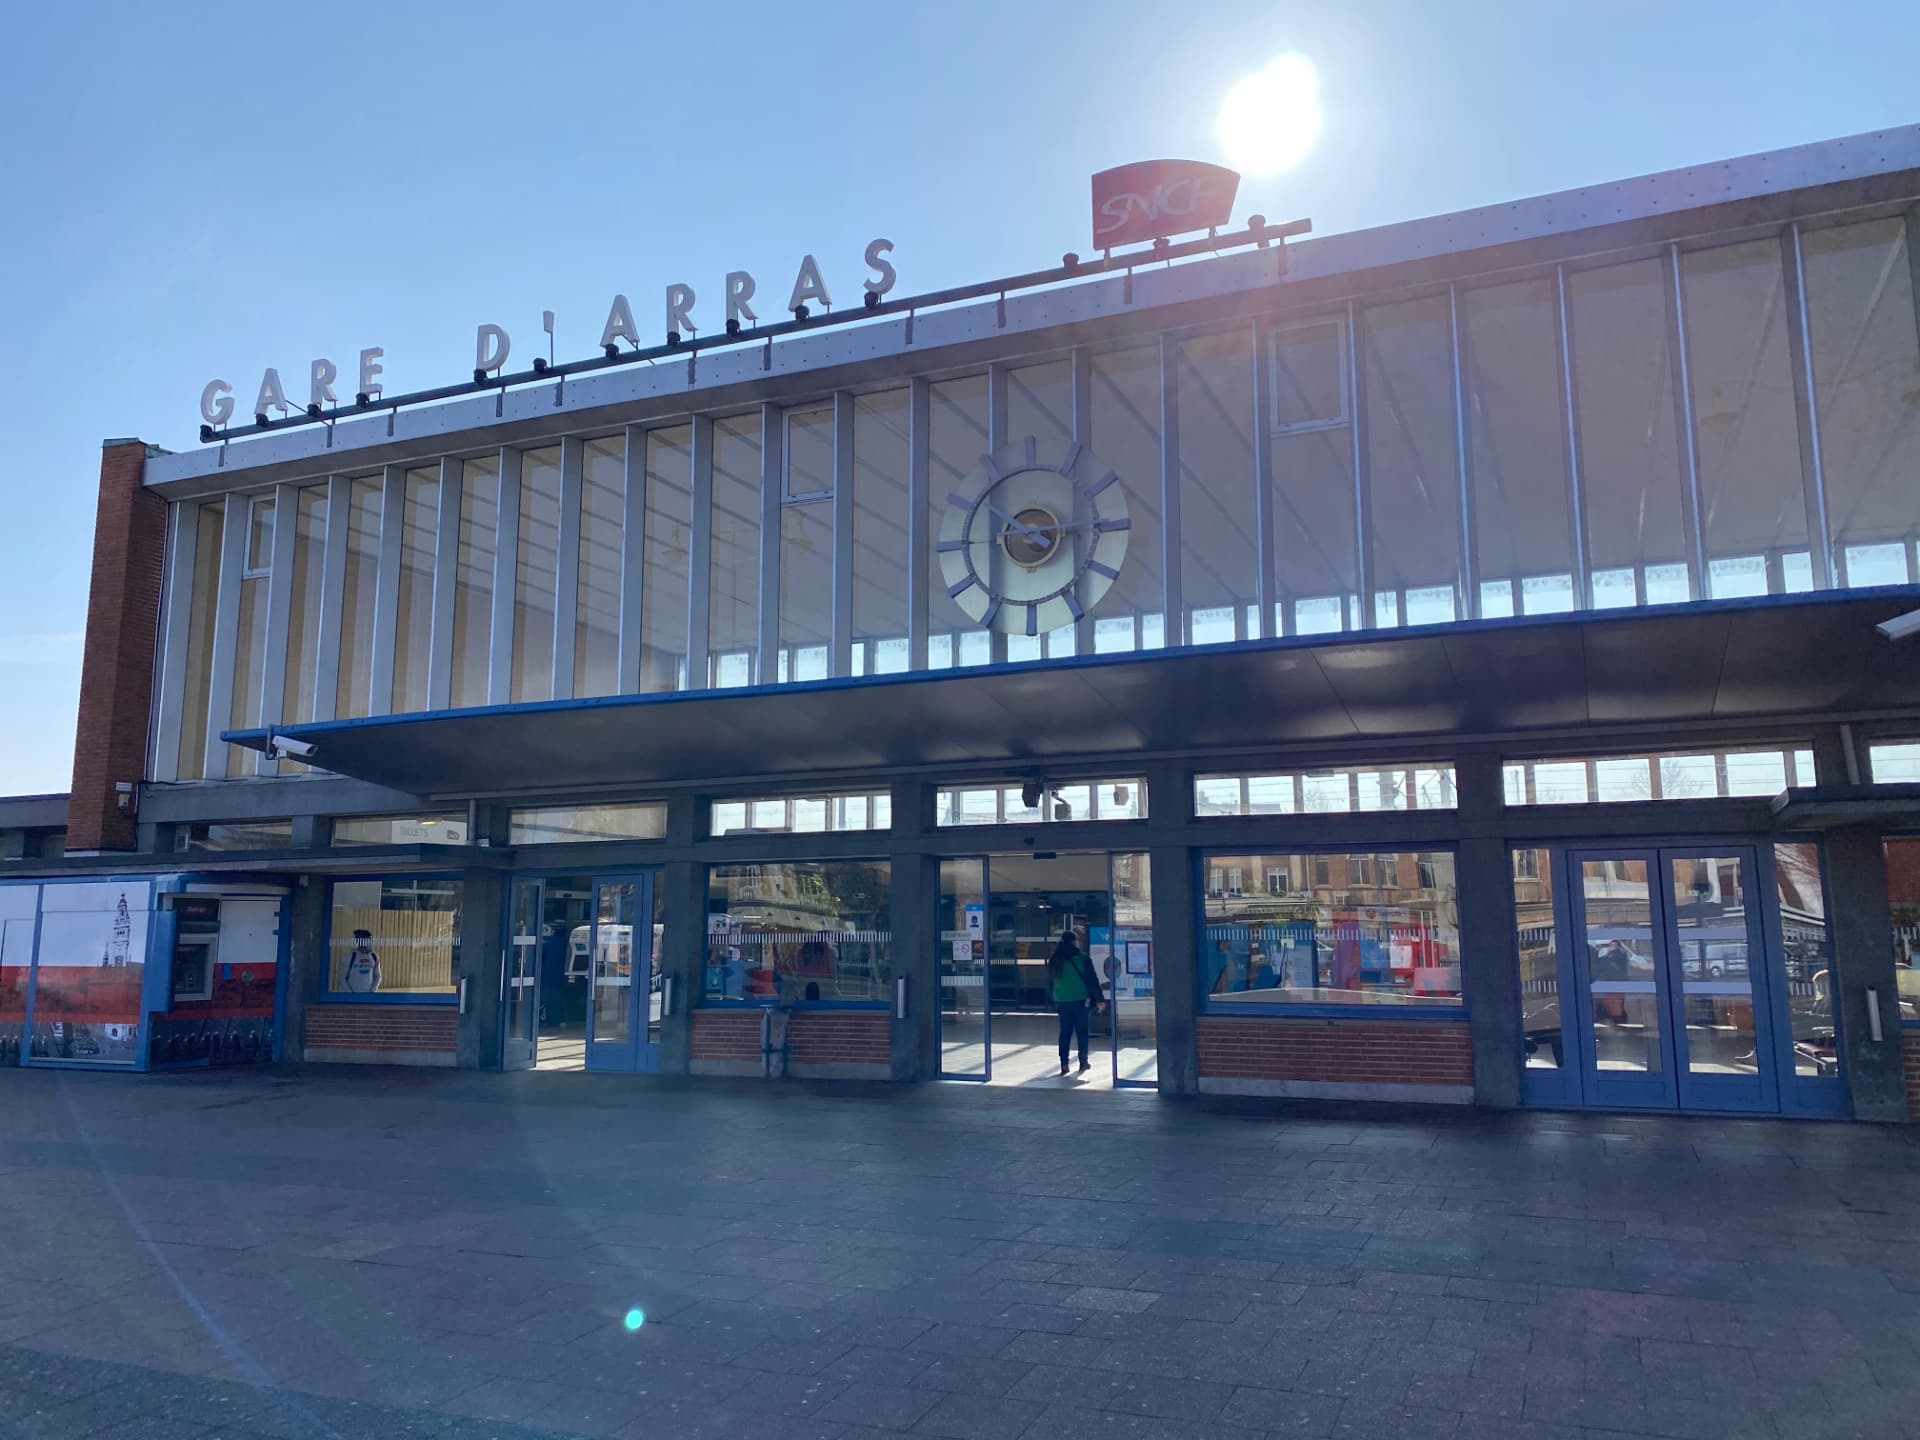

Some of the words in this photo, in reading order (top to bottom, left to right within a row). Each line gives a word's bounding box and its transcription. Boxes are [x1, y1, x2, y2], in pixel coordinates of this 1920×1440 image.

[1096, 177, 1218, 234] SNCF
[200, 346, 384, 426] GARE
[400, 826, 429, 838] BILLETS
